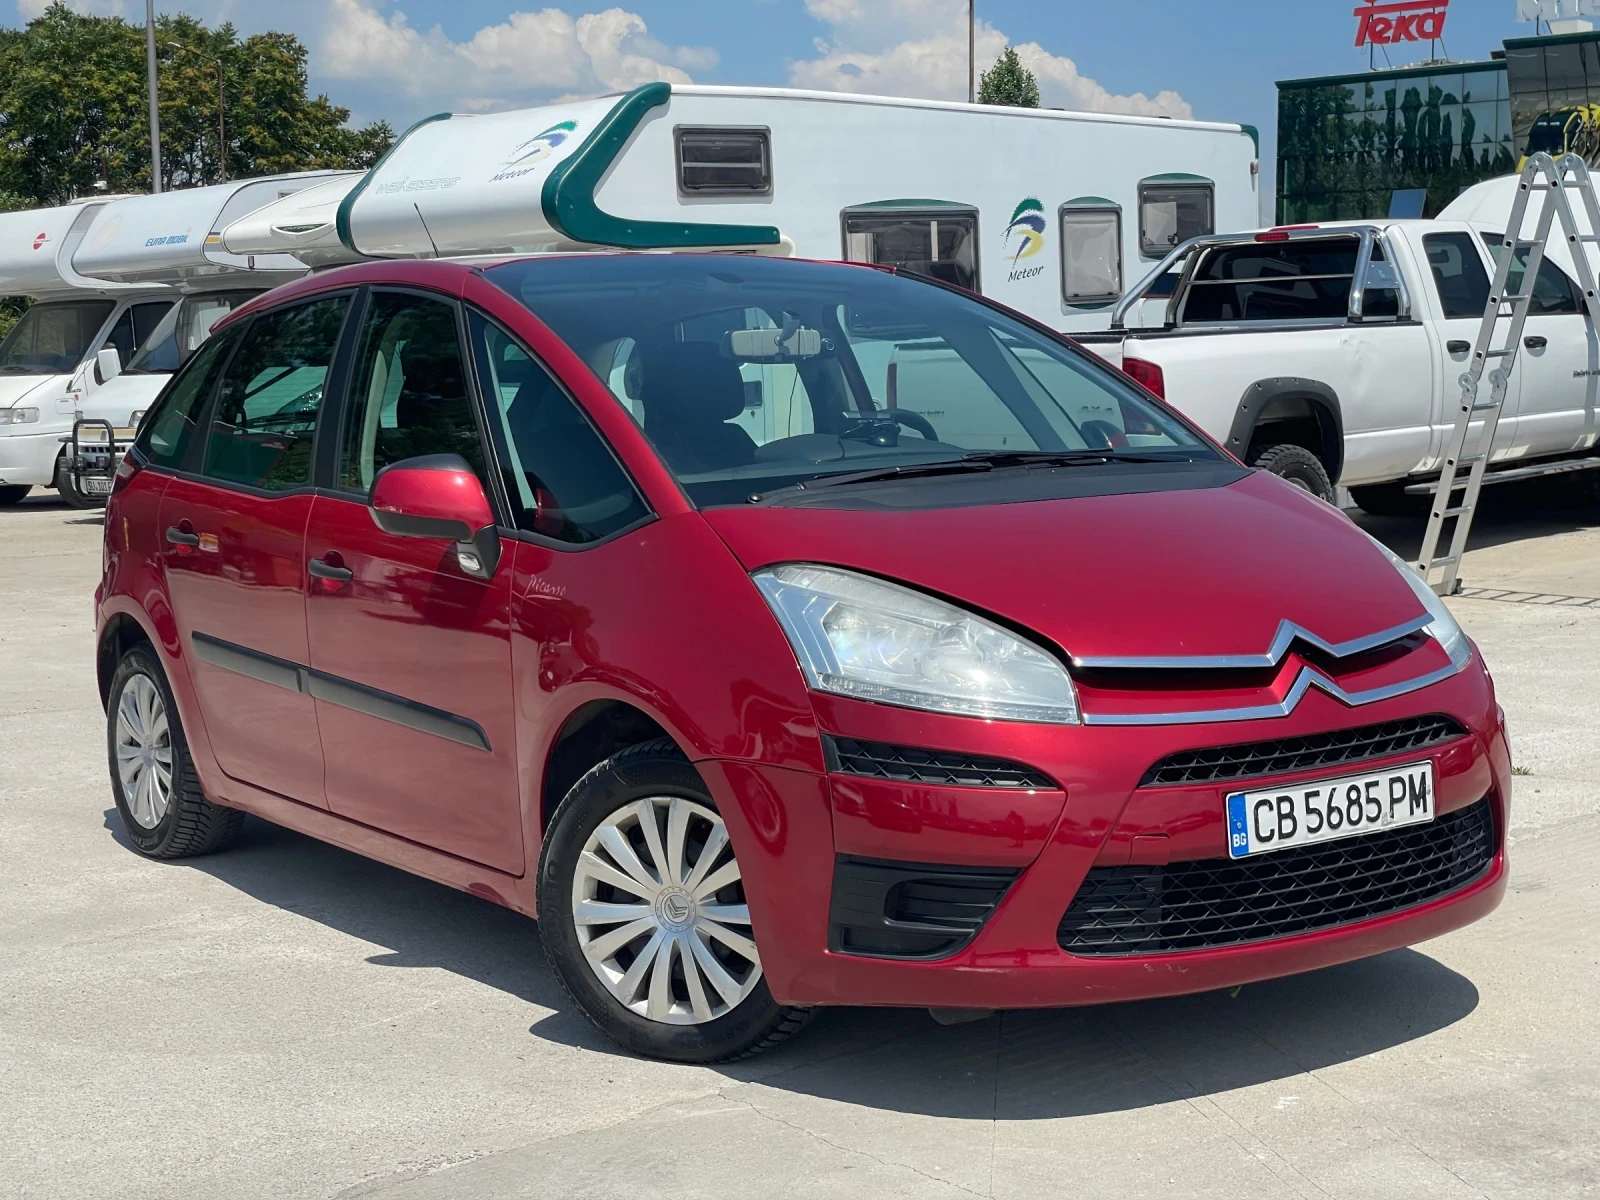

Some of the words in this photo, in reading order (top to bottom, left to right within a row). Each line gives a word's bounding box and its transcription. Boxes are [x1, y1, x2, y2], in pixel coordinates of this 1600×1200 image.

[1353, 0, 1449, 46] Teka
[488, 168, 535, 182] Meteor
[145, 238, 167, 247] EURA
[165, 235, 189, 244] MOBIL
[1007, 265, 1044, 282] Meteor
[1253, 795, 1297, 843] CB
[1304, 780, 1382, 834] 5685
[1389, 771, 1428, 819] PM
[1233, 833, 1247, 847] BG
